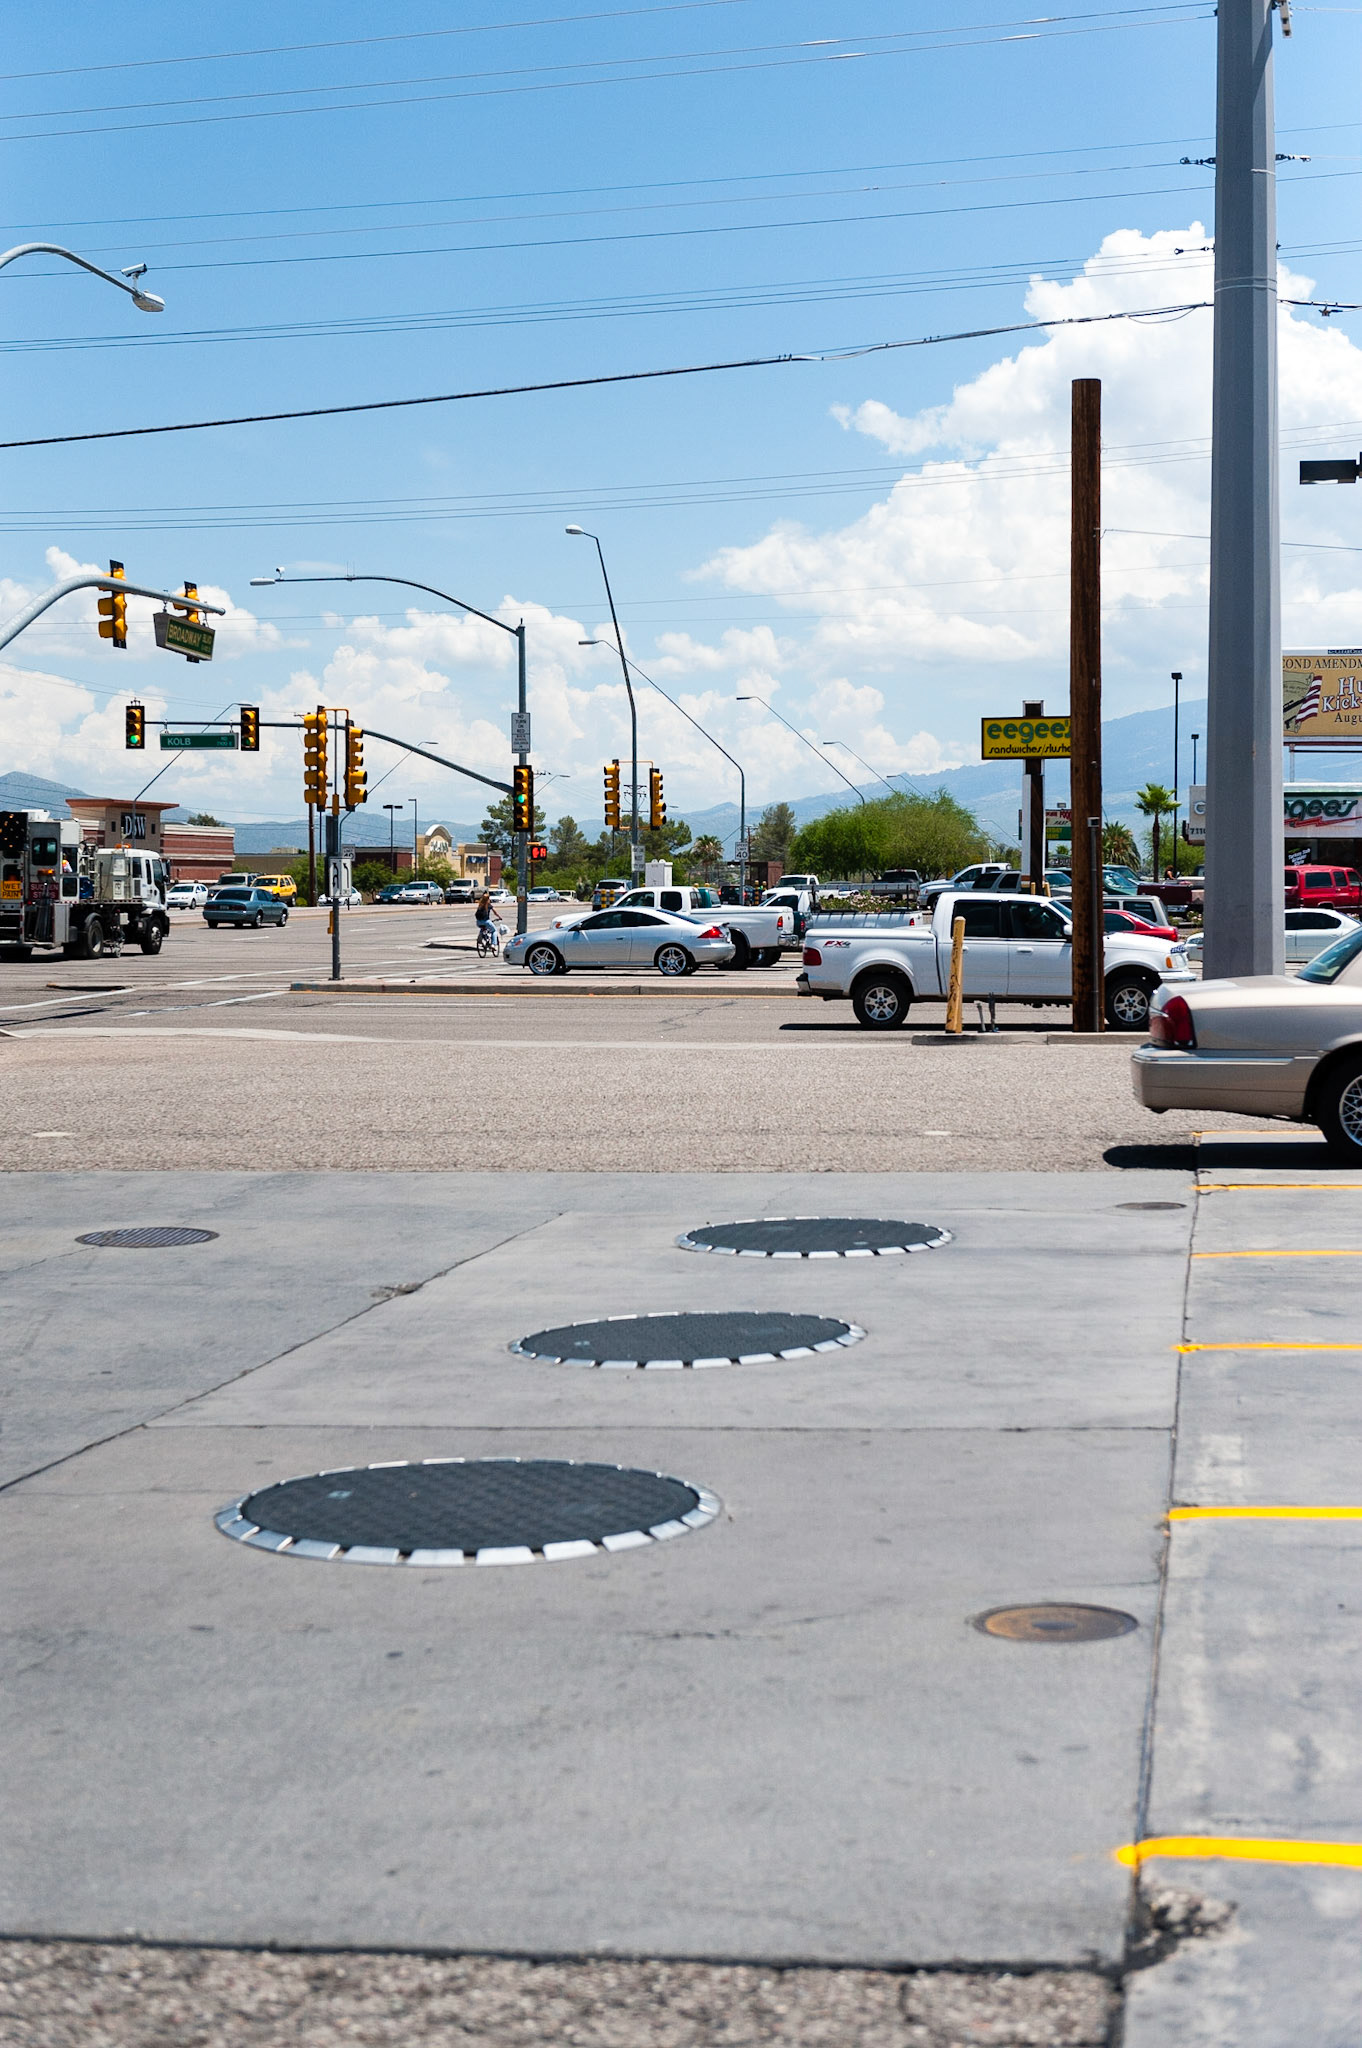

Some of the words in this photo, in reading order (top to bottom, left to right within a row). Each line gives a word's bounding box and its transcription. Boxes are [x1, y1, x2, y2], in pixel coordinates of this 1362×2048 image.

[168, 624, 200, 647] BROADWAY
[1283, 658, 1311, 669] OND
[167, 737, 191, 746] KOLB
